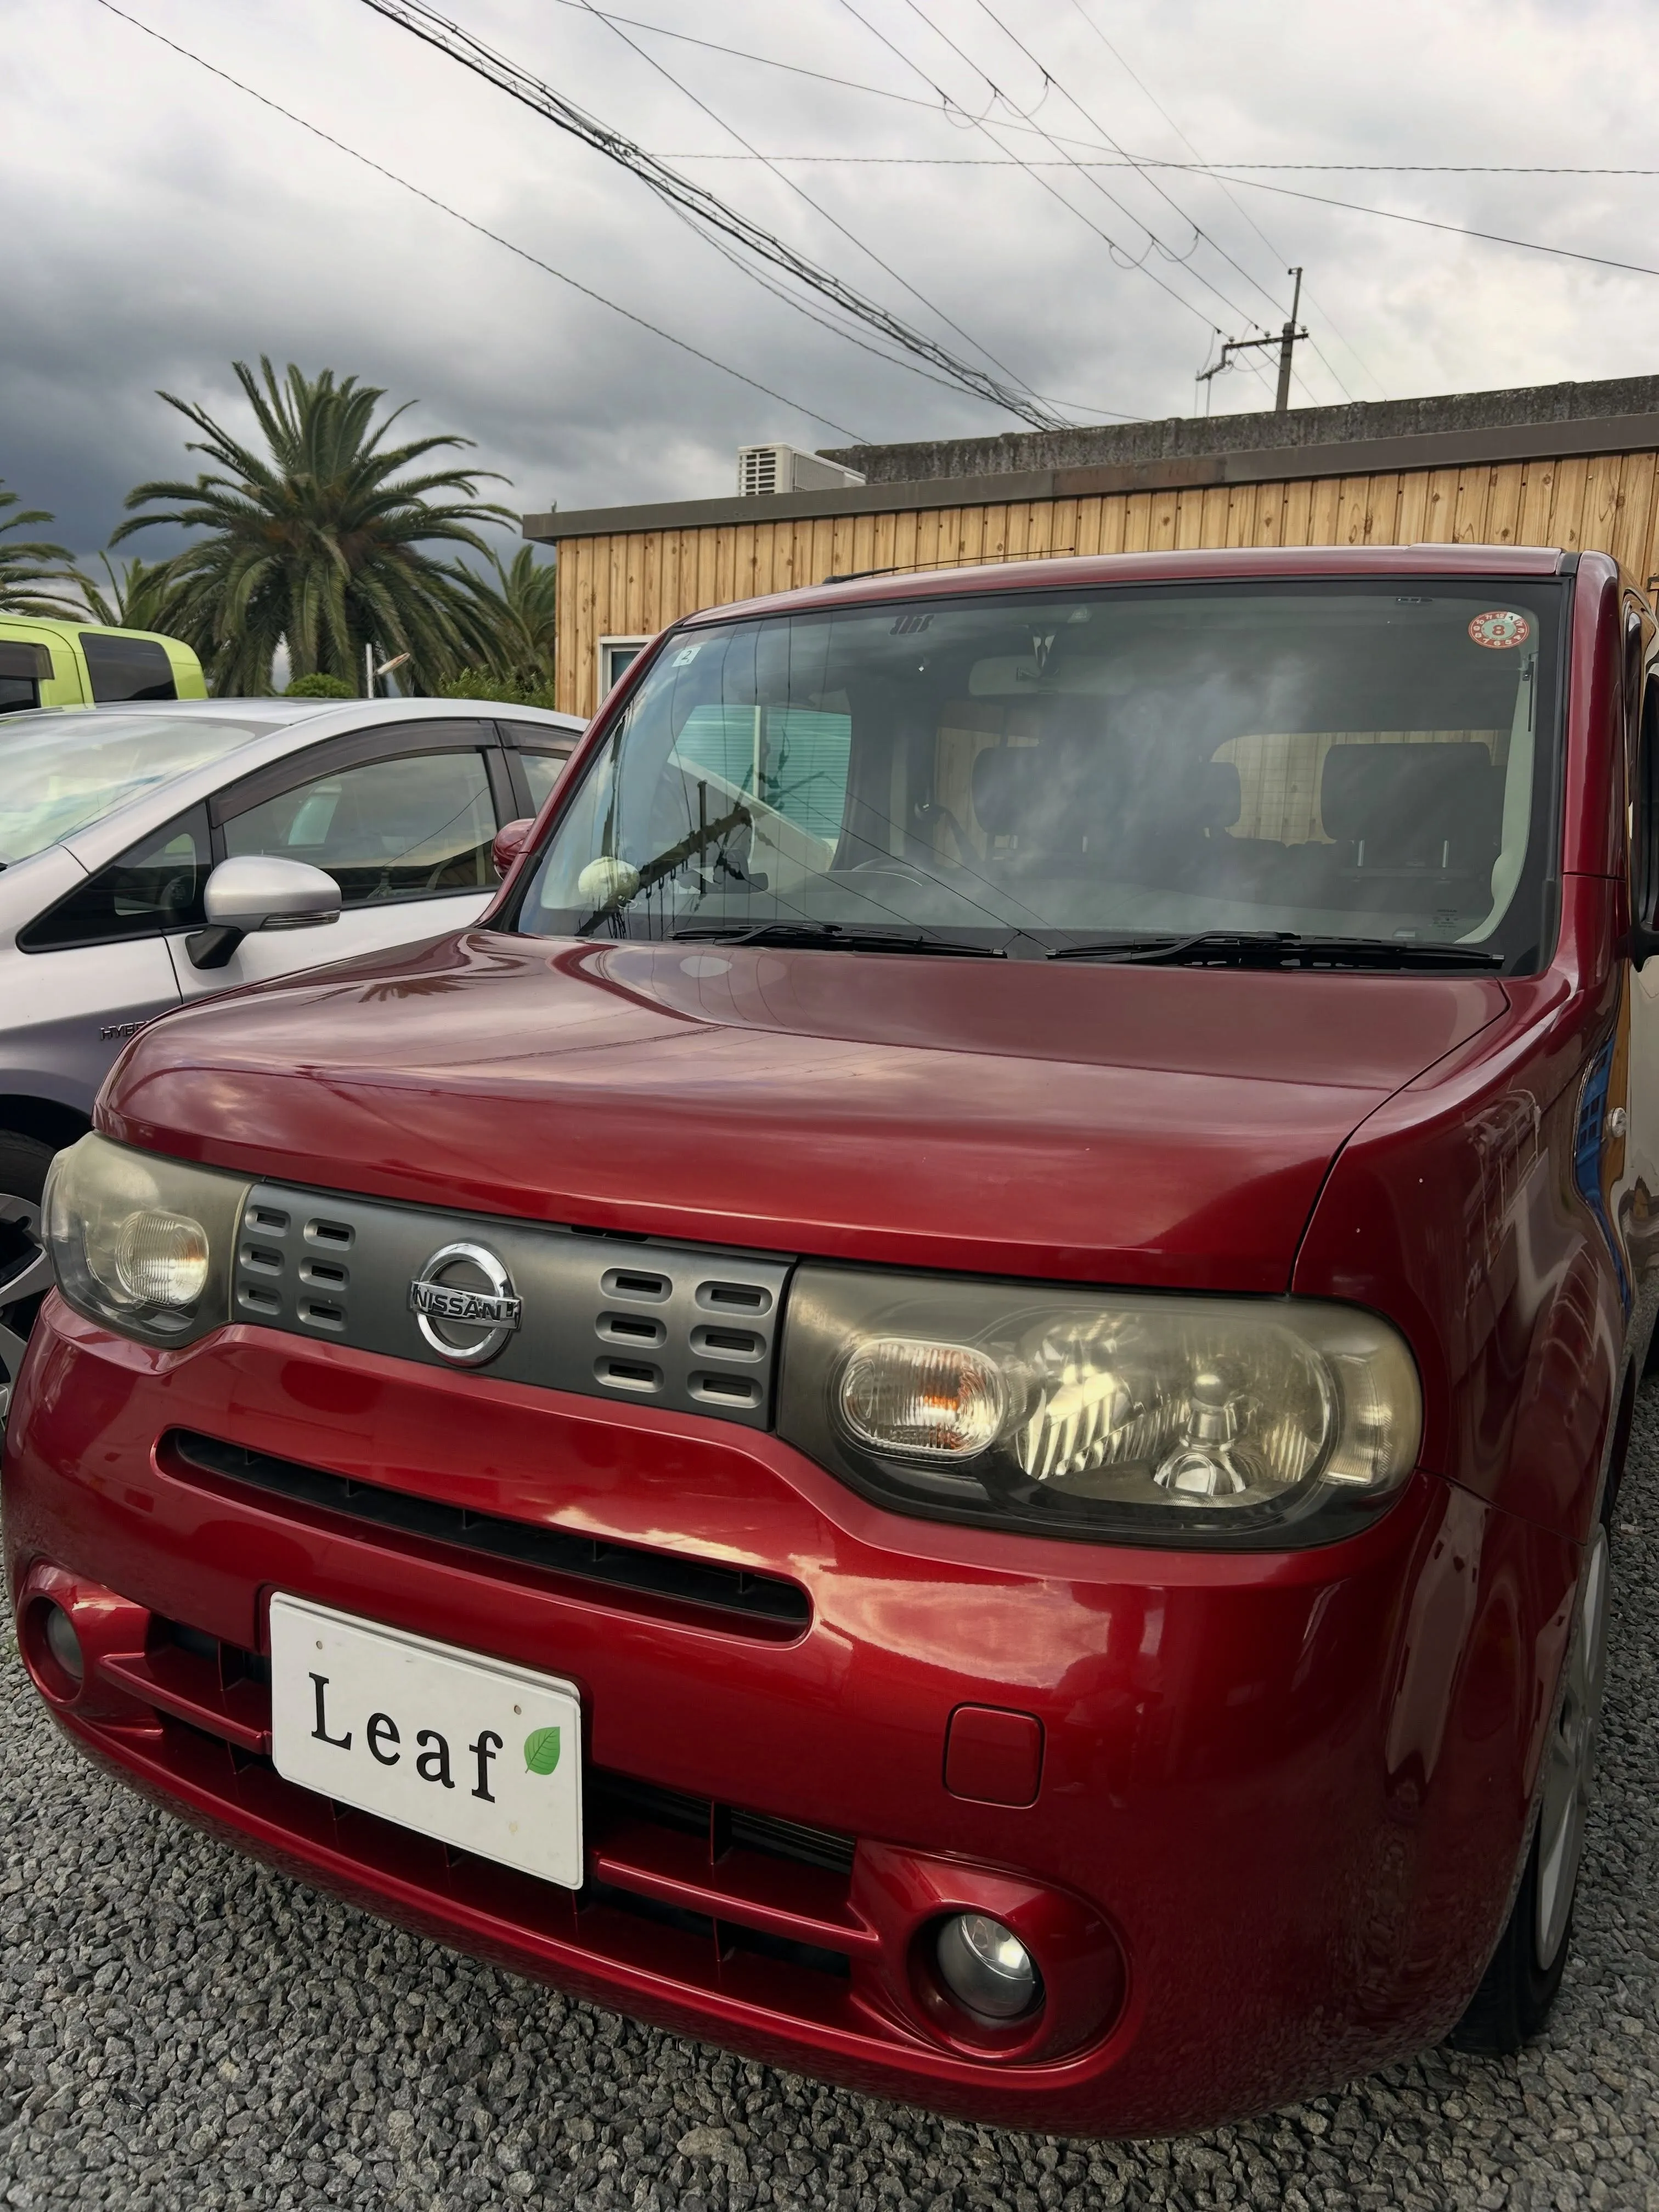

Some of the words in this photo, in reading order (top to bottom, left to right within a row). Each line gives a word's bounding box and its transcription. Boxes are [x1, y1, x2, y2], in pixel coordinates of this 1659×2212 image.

[1492, 625, 1505, 636] 8
[681, 650, 692, 660] 2
[414, 1284, 501, 1321] NISSAN
[308, 1672, 503, 1803] Leaf
